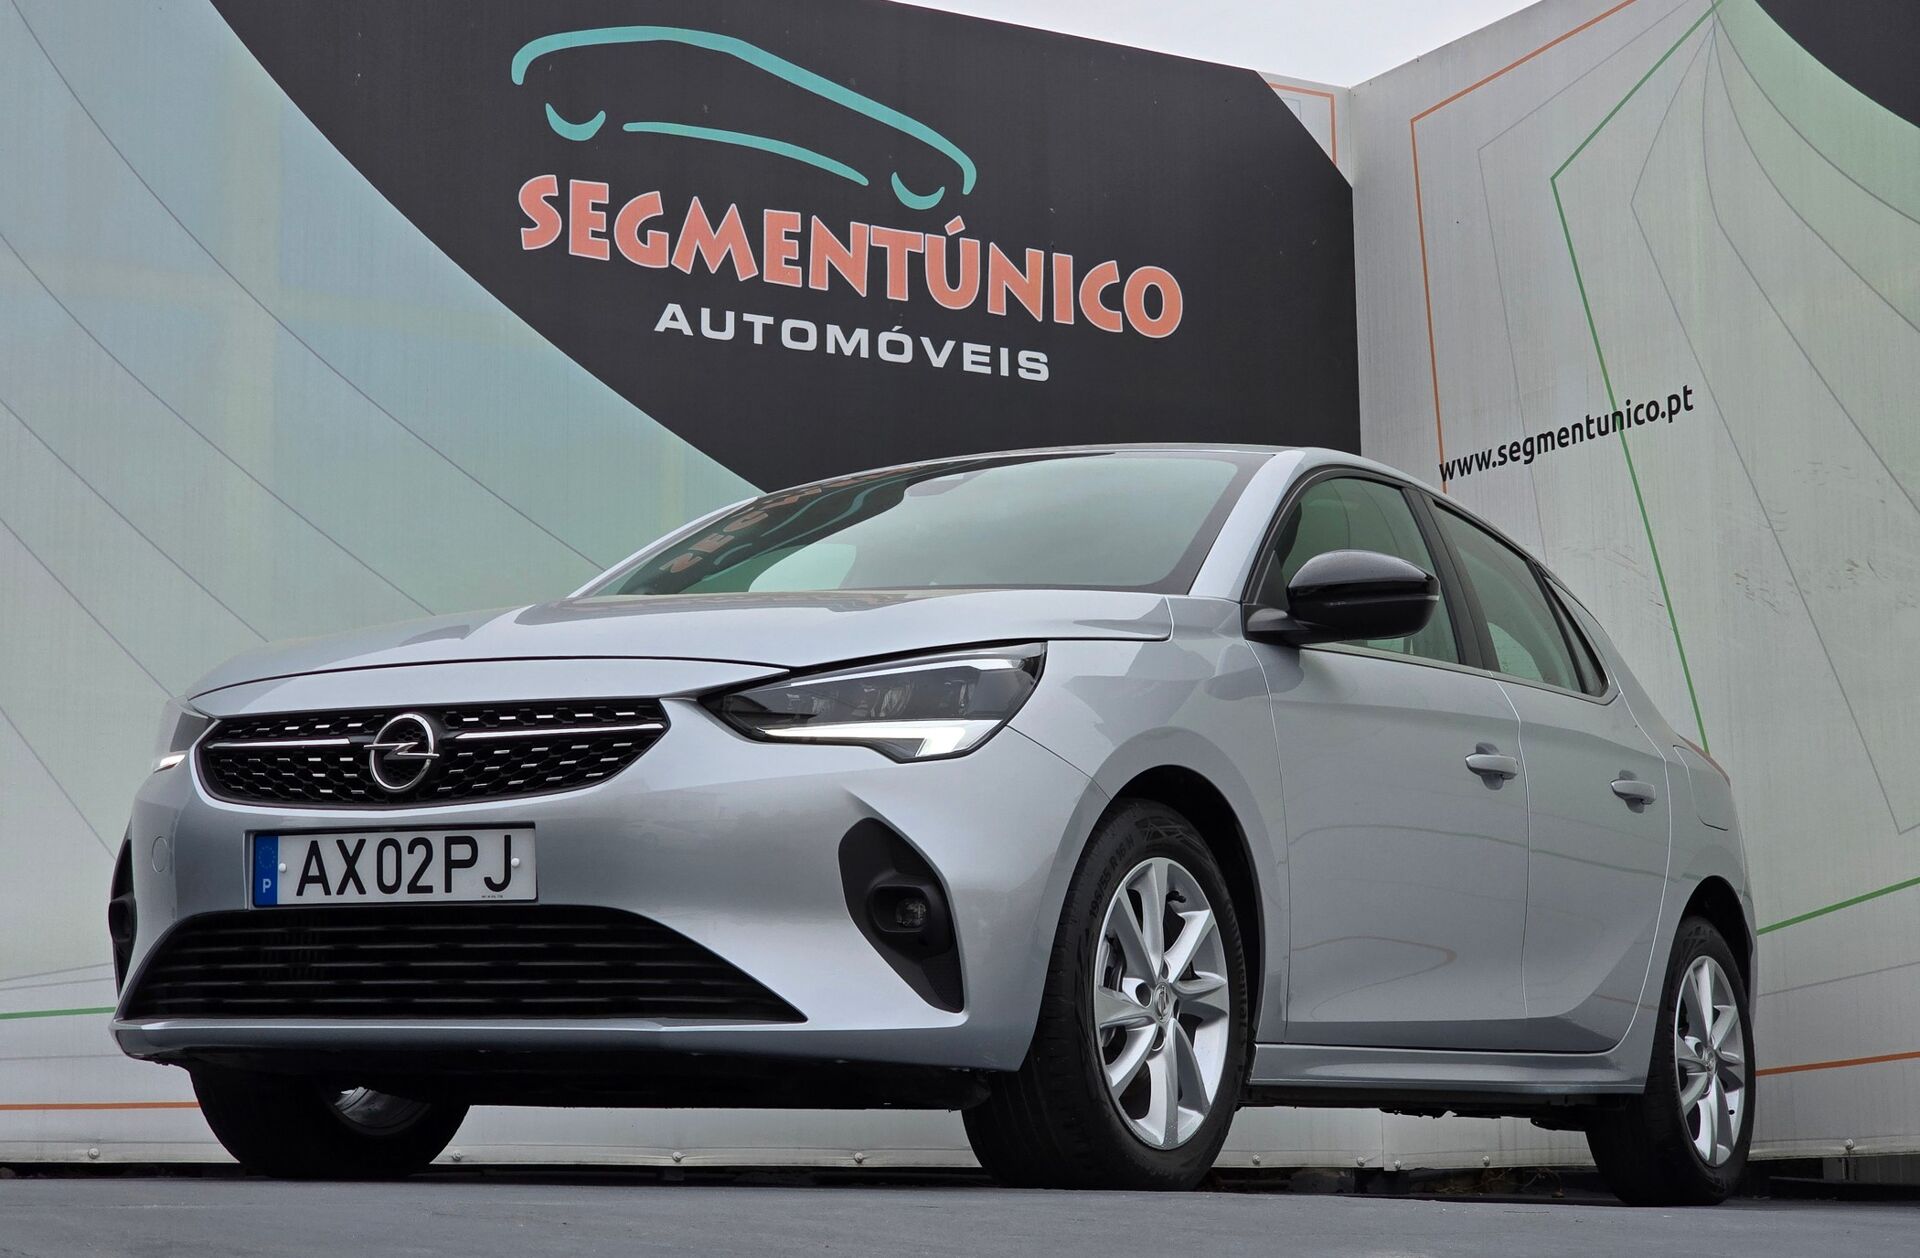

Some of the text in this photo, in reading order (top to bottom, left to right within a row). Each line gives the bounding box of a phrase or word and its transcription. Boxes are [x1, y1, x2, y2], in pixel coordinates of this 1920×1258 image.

[518, 174, 1184, 339] SEGMENTÚNICO
[654, 303, 1051, 382] AUTOMÓVEIS
[1439, 385, 1694, 482] www.segmentunico.pt
[262, 878, 272, 893] P
